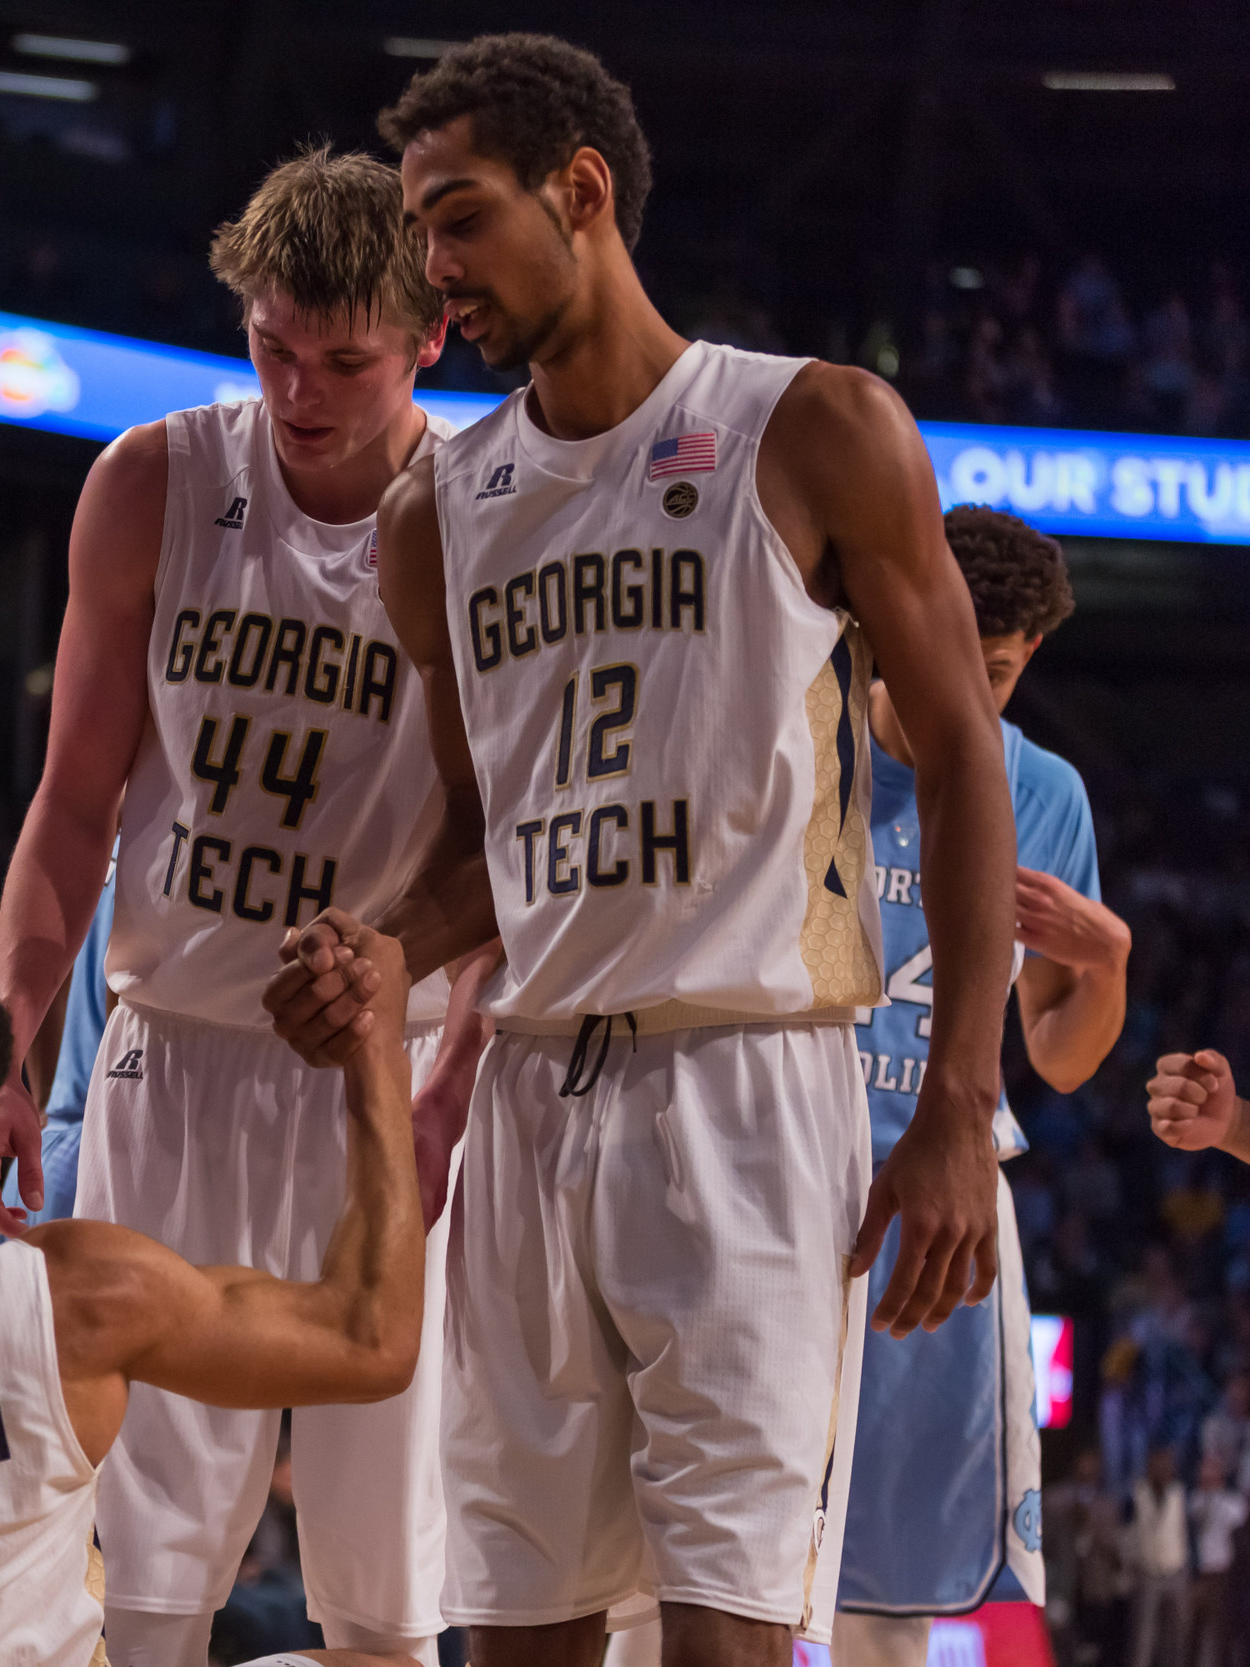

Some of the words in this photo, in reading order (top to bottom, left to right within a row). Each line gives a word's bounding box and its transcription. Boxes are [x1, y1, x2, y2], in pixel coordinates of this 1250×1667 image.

[950, 447, 1097, 515] OUR
[164, 607, 399, 724] GEORGIA
[467, 547, 708, 676] GEORGIA
[190, 712, 331, 830] 44
[554, 661, 641, 792] 12
[162, 821, 339, 929] TECH
[515, 799, 693, 907] TECH
[105, 1070, 144, 1080] RUSSELL
